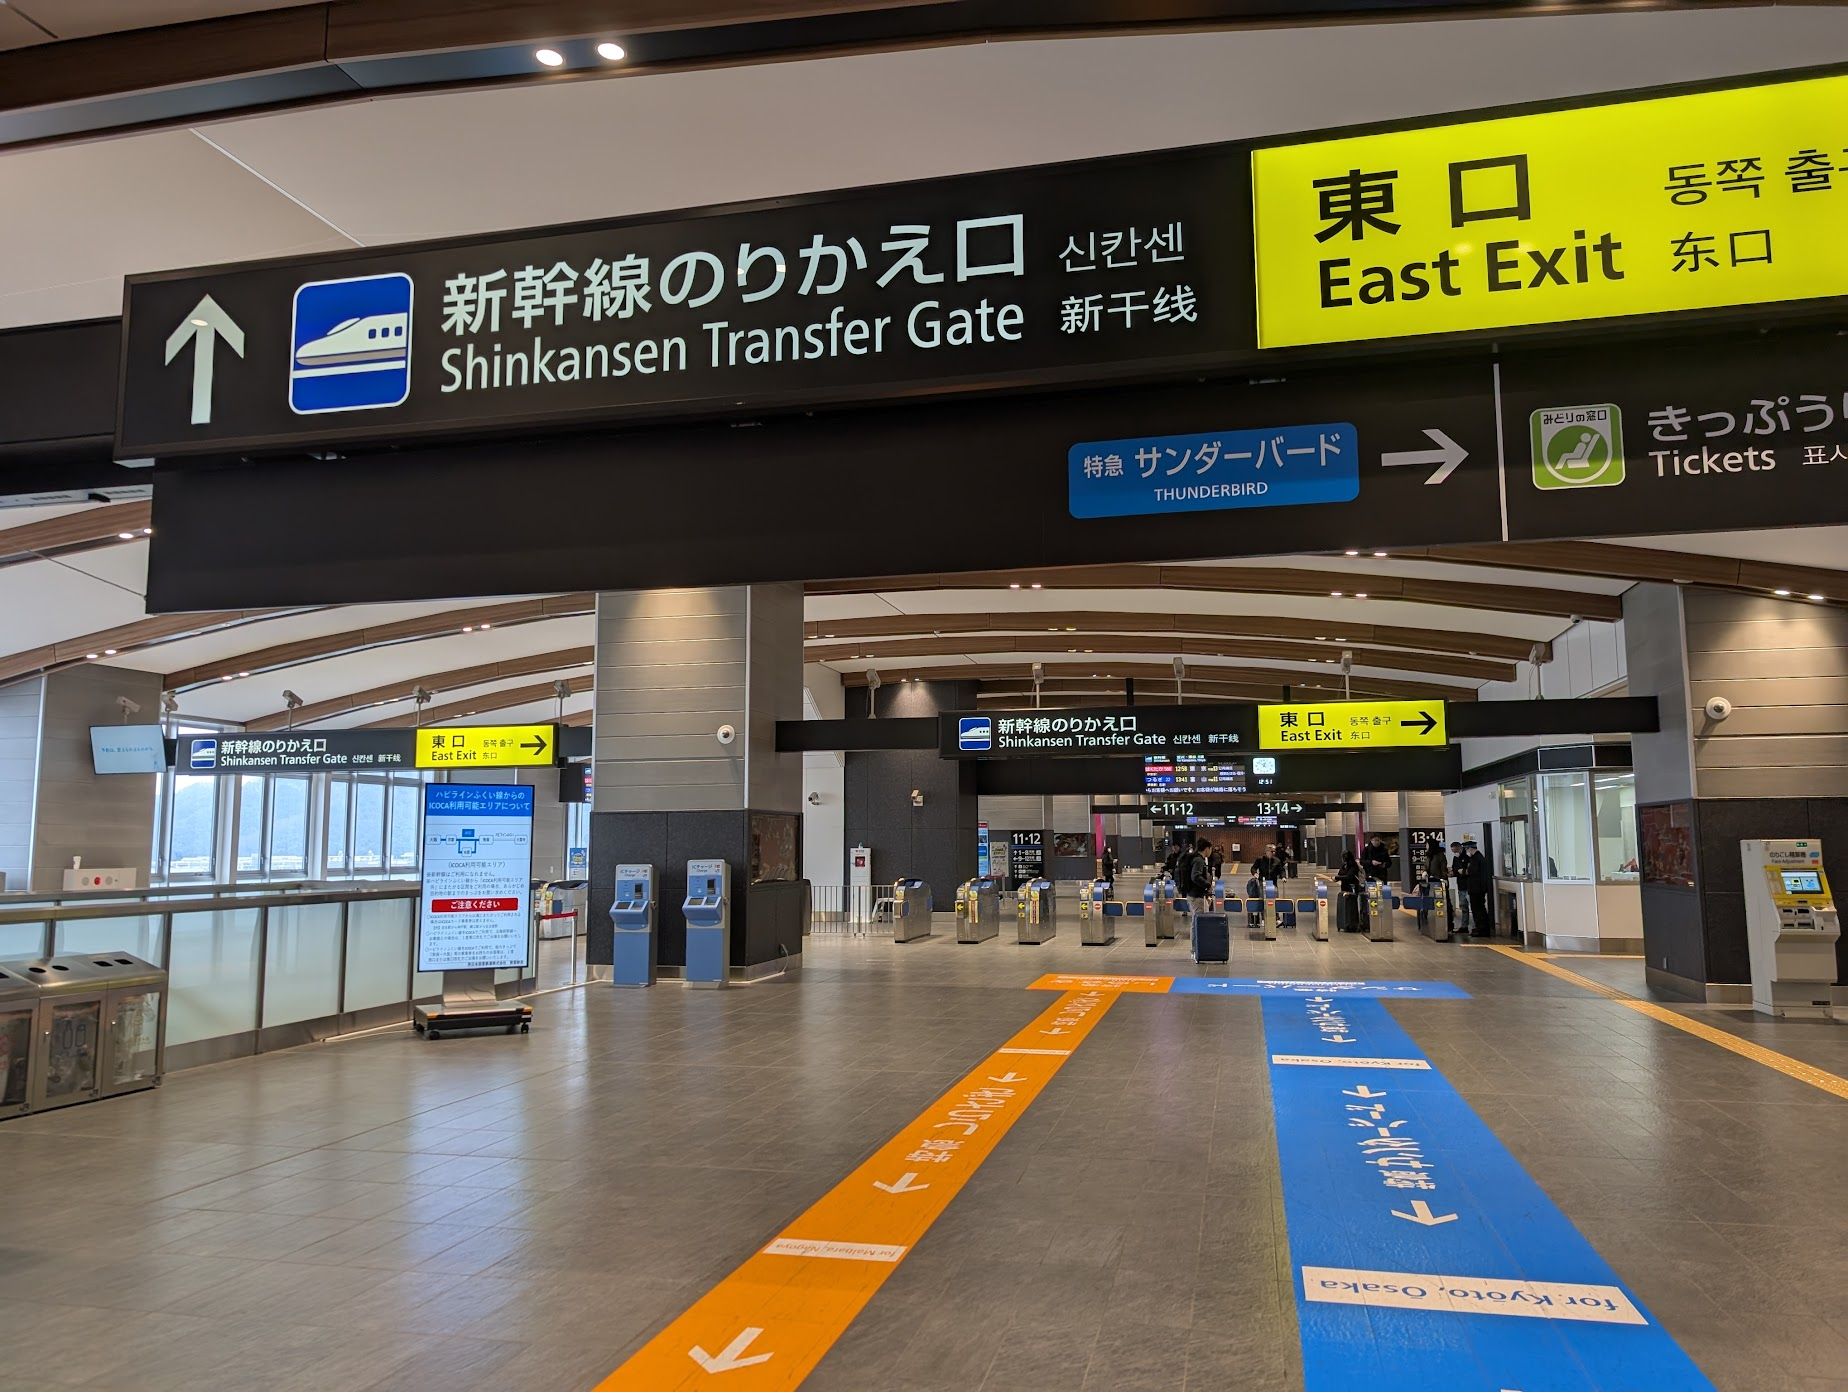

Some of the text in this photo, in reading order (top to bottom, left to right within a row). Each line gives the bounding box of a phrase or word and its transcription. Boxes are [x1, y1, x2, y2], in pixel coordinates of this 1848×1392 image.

[1664, 148, 1848, 206] 동쪽 출
[1058, 222, 1185, 272] 신칸센
[1671, 229, 1774, 273] 东口
[441, 214, 1025, 336] 新幹線のりかえ口
[1319, 230, 1625, 309] East Exit
[1060, 285, 1198, 335] 新干线
[440, 298, 1025, 393] Shinkansen Transfer Gate
[1543, 410, 1607, 425] みどりの窓口
[1083, 432, 1342, 478] 特急 サンダーバード
[1649, 446, 1777, 477] Tickets
[1154, 481, 1269, 502] THUNDERBIRD
[998, 716, 1137, 734] 新幹線のりかえ口
[998, 732, 1166, 748] Shinkansen Transfer Gate
[1208, 733, 1240, 744] 新干线
[1281, 728, 1343, 742] East Exit
[221, 738, 326, 755] 新幹線のりかえ口
[431, 750, 477, 761] East Exit
[220, 753, 348, 767] Shinkansen Transfer Gate
[429, 801, 531, 810] ICOCA利用可能エリアについて
[450, 900, 501, 910] ご注意ください
[1565, 1297, 1620, 1312] for
